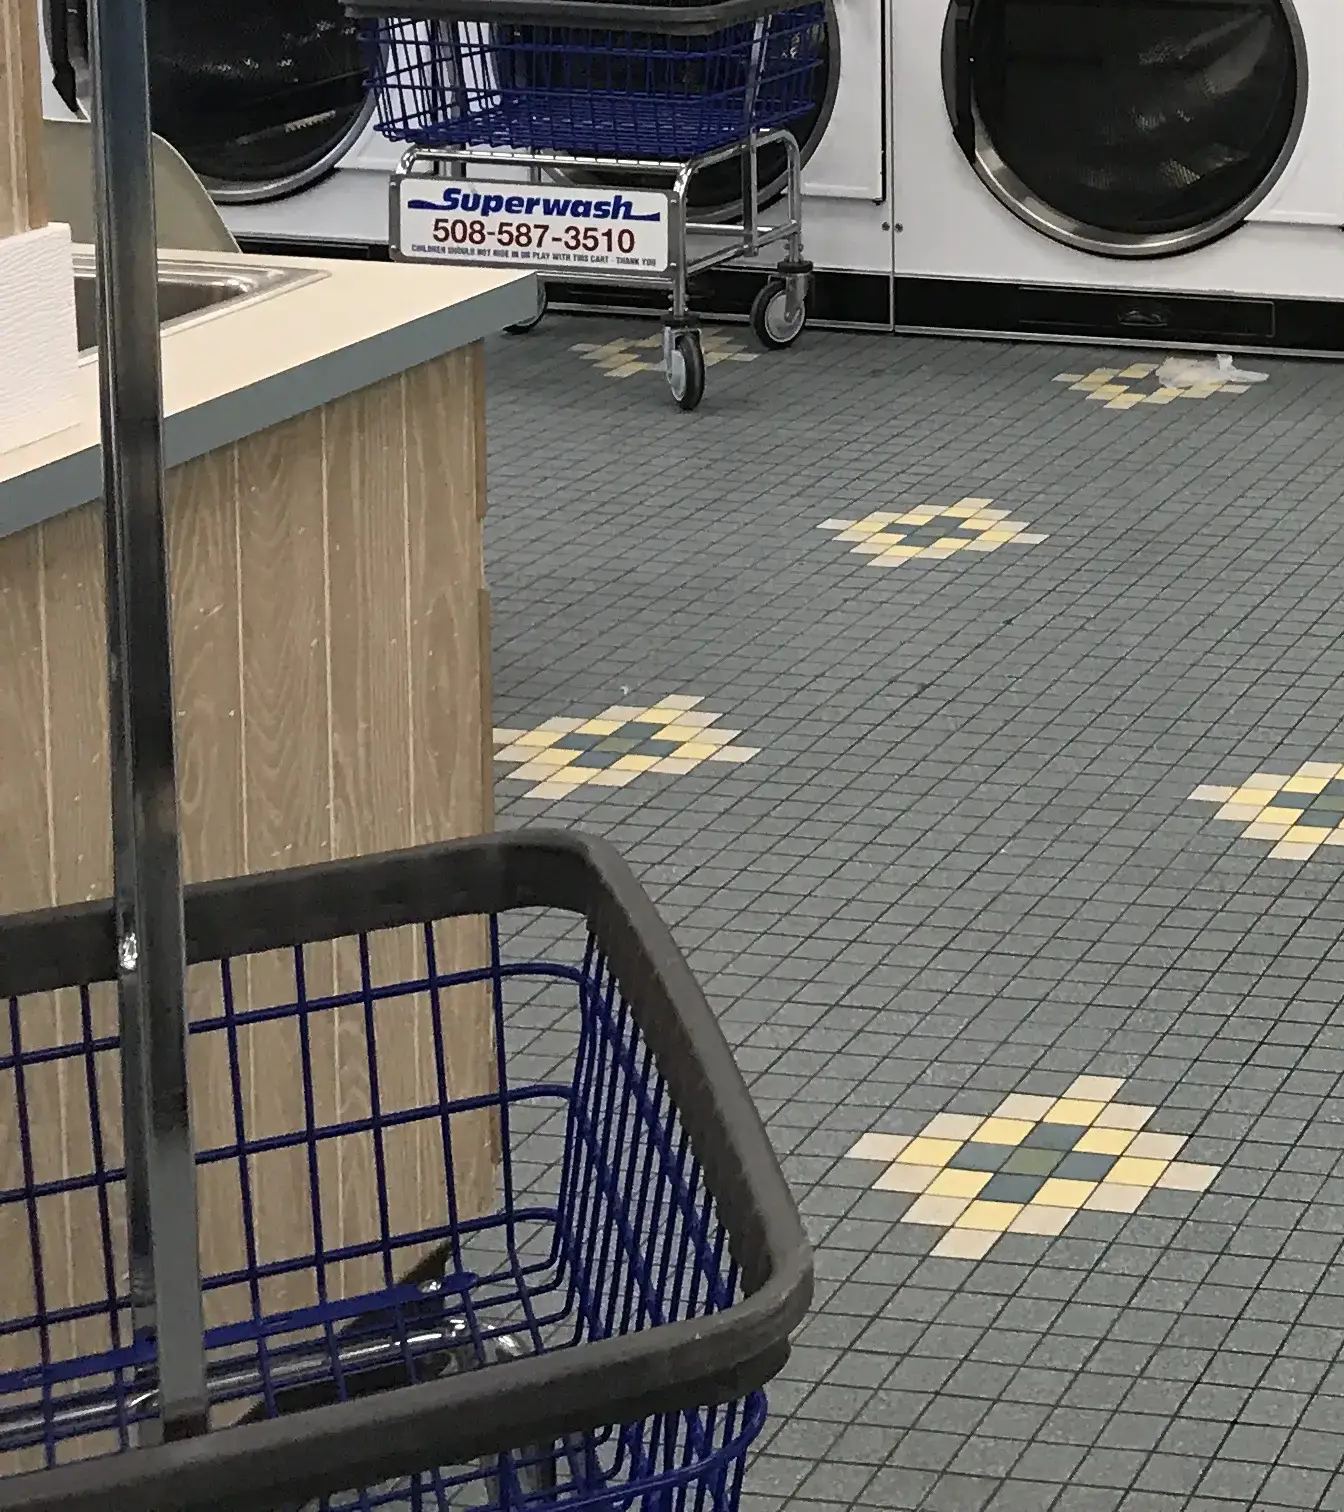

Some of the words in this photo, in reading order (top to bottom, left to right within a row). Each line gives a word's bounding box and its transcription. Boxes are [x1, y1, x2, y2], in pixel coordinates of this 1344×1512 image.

[441, 187, 634, 221] Superwash
[433, 218, 636, 254] 508-587-3510
[533, 252, 550, 260] PLAY
[552, 253, 571, 262] WITH
[573, 254, 589, 262] THIS
[590, 255, 609, 264] CART
[616, 256, 639, 265] THANK
[641, 258, 656, 267] YOU
